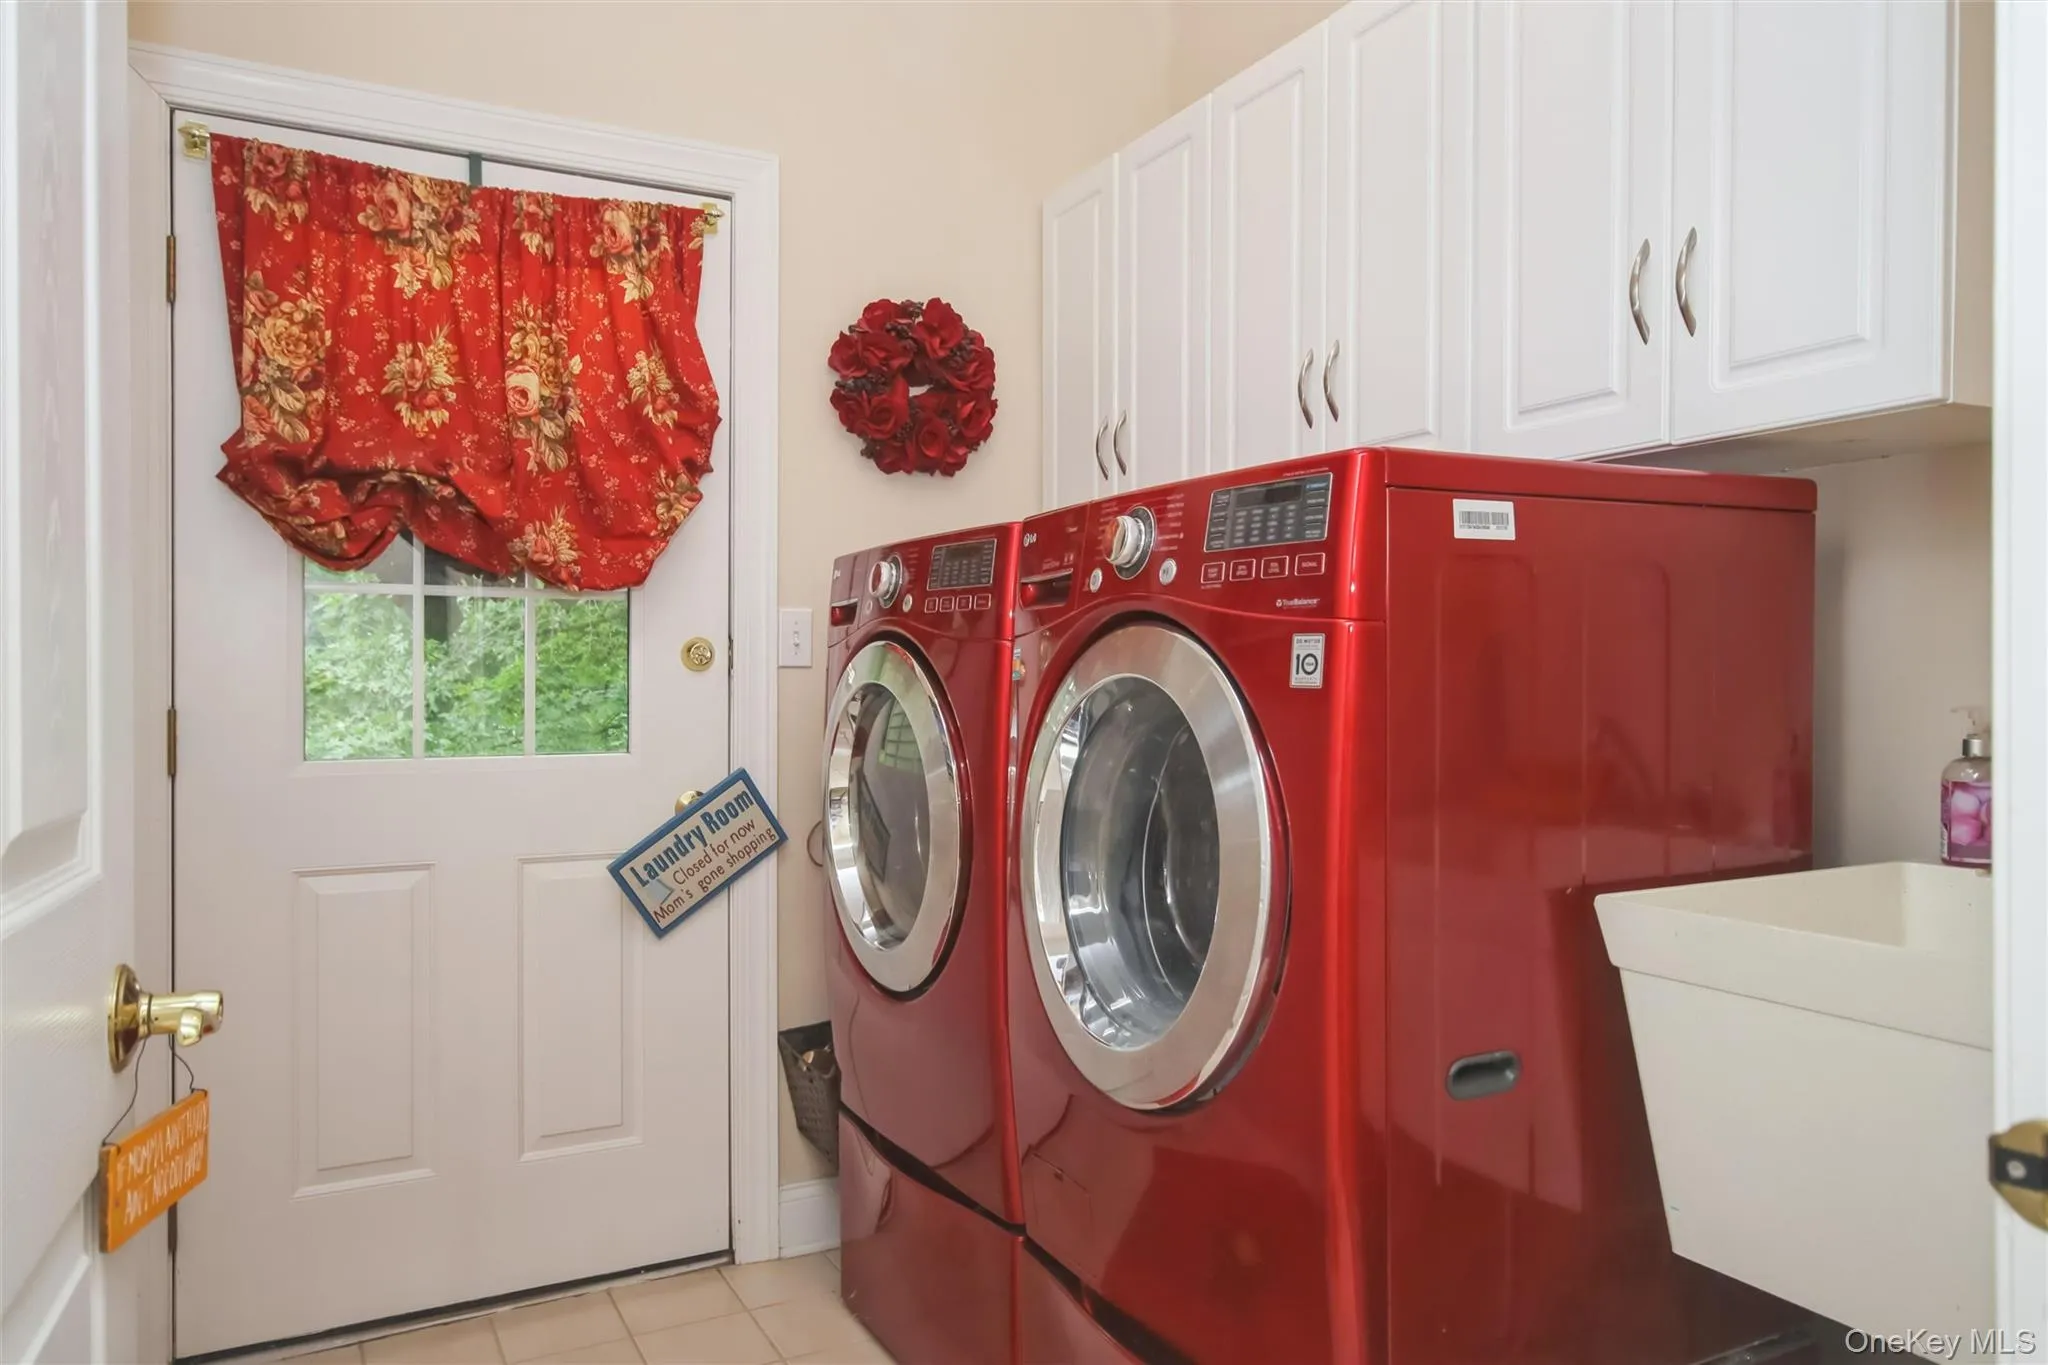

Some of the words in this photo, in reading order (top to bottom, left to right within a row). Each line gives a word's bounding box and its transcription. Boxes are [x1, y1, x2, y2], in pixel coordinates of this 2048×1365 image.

[1296, 653, 1318, 675] 10
[630, 824, 709, 887] Laundry
[700, 789, 754, 835] Room
[653, 888, 694, 923] Mom's
[697, 864, 726, 892] gone
[726, 827, 777, 868] shopping
[672, 850, 713, 886] Closed
[709, 839, 730, 858] for
[730, 819, 756, 845] now
